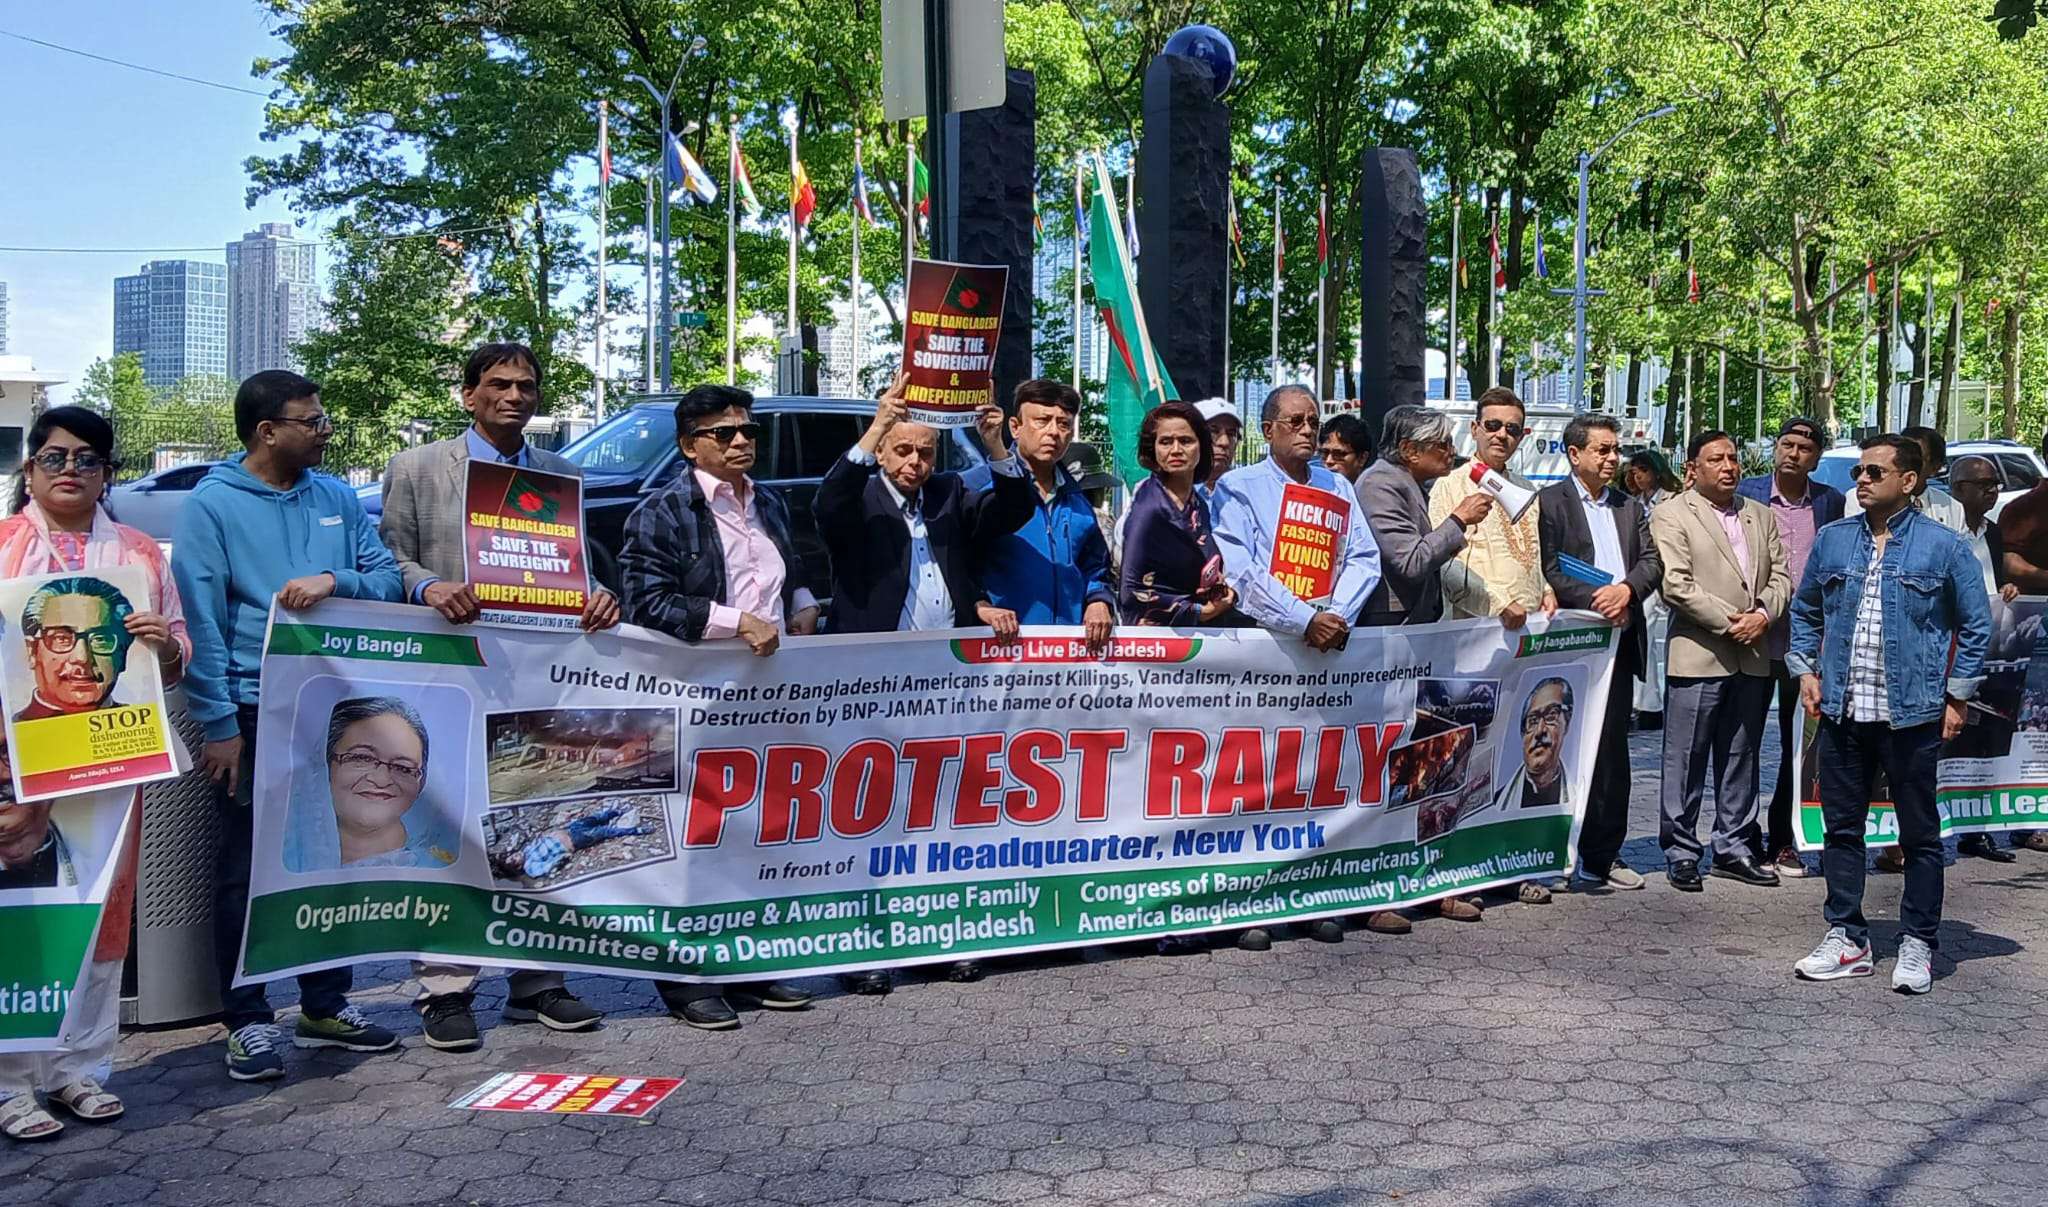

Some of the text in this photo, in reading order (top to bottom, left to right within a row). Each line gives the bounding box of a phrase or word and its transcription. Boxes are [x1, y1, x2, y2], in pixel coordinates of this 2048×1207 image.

[911, 311, 998, 330] SAVE BANGLADESH
[928, 334, 984, 353] SAVE THE
[913, 350, 990, 371] SOVREIGNTY
[950, 373, 959, 386] &
[471, 512, 576, 539] SAVE BANGLADESH
[1285, 500, 1343, 533] KICK OUT
[491, 535, 559, 556] SAVE THE
[1281, 524, 1332, 546] FASCIST
[478, 551, 570, 573] SOVREIGNTY
[1279, 541, 1330, 571] YUNUS
[523, 571, 536, 584] &
[474, 583, 583, 608] INDEPENDENCE
[321, 632, 423, 658] Joy Bangla
[981, 641, 1022, 661] Long
[1027, 640, 1063, 658] Live
[549, 662, 1431, 703] United Movement of Bangladeshi Americans against Killings, Vandalism, Arson and unprecedented
[88, 708, 151, 733] STOP
[689, 691, 1353, 727] Destruction by BNP-JAMAT in the name of Quota Movement in Bangladesh
[90, 727, 156, 744] dishonoring
[682, 722, 1406, 848] PROTEST RALLY
[758, 821, 1325, 881] in front of UN Headquarter, New York
[1078, 904, 1165, 934] America
[1170, 891, 1287, 926] Bangladesh
[1290, 880, 1395, 907] Community
[1495, 847, 1555, 876] Initiative
[1080, 880, 1183, 907] Congress
[1187, 876, 1209, 896] of
[1213, 858, 1328, 896] Bangladeshi
[1330, 849, 1419, 877] Americans
[295, 895, 451, 933] Organized by:
[491, 881, 1040, 938] USA Awami League & Awami League Family
[485, 909, 1035, 966] Committee for a Democratic Bangladesh
